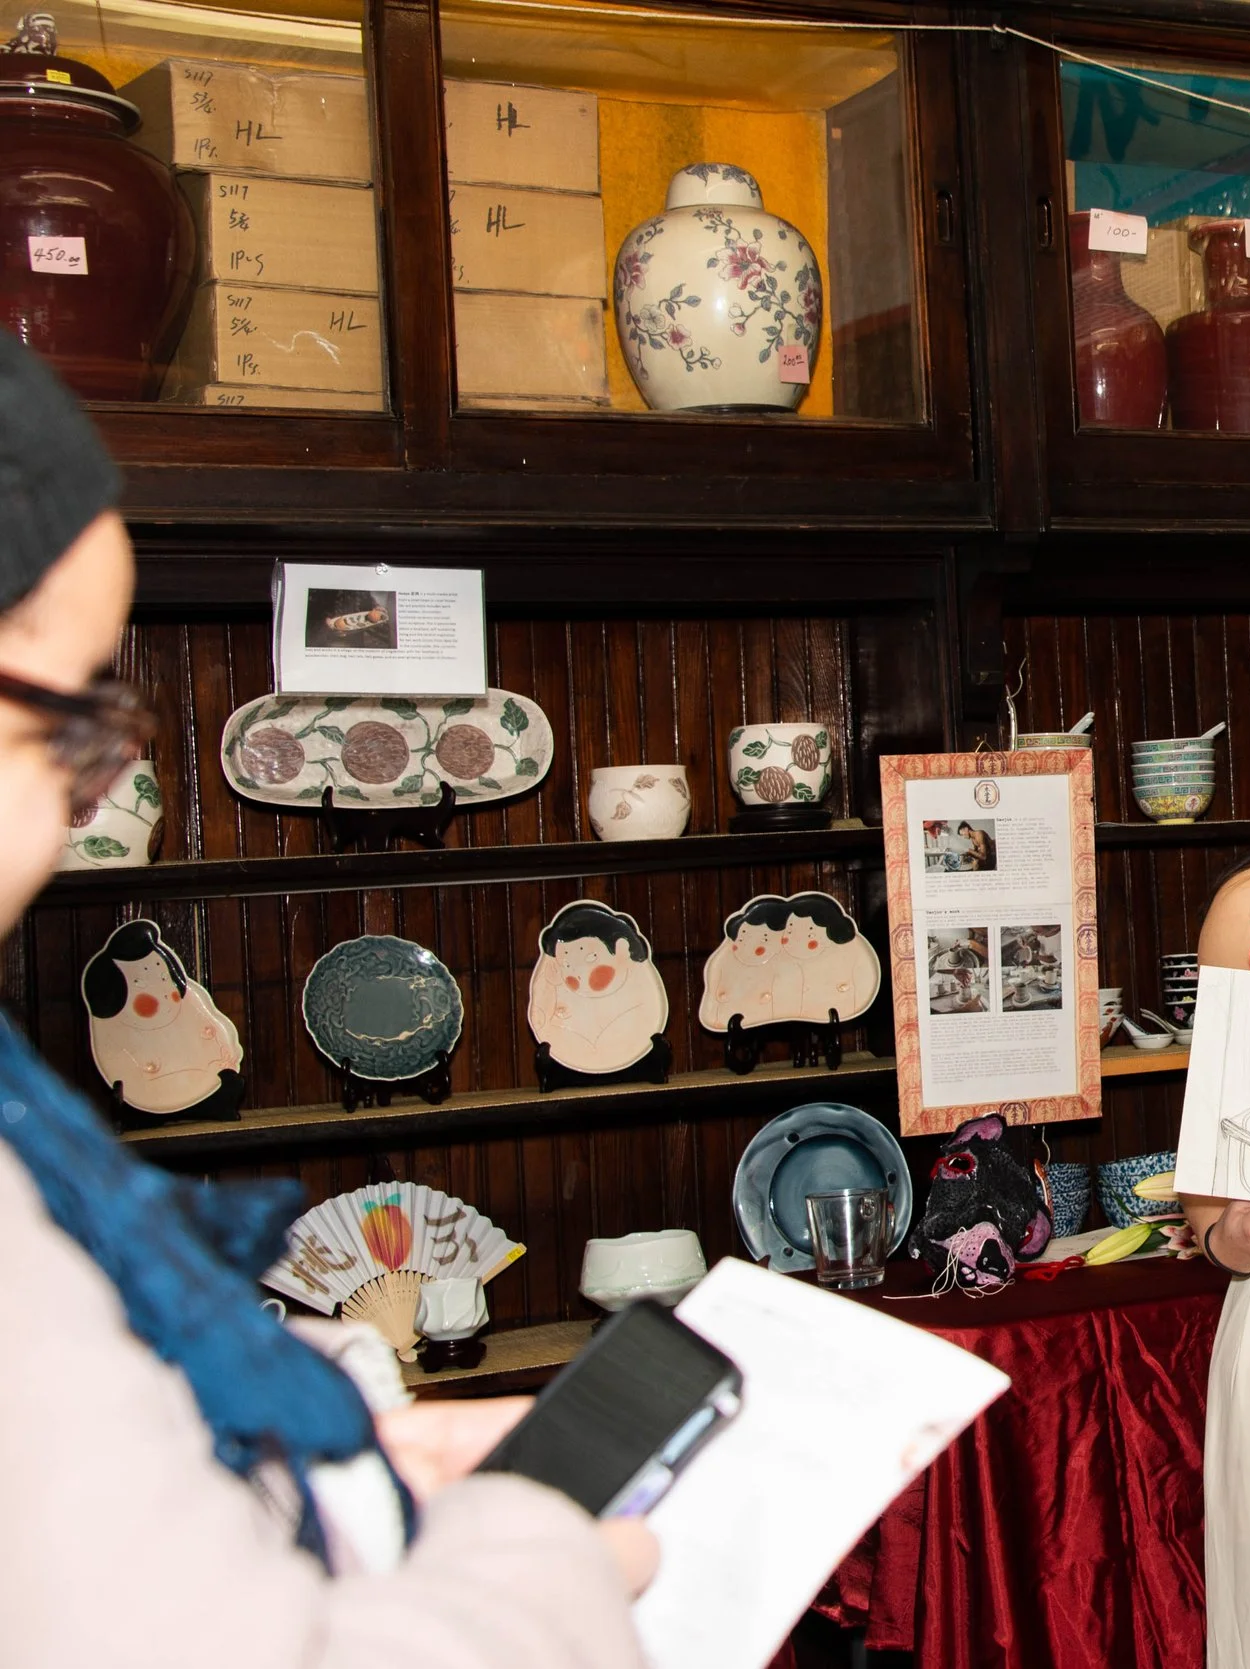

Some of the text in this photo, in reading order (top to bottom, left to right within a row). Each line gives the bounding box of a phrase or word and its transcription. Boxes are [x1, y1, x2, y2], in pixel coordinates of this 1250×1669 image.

[184, 69, 213, 87] S117
[235, 120, 283, 146] HL
[219, 185, 249, 200] S117
[487, 204, 526, 237] HL
[227, 294, 253, 310] S117
[329, 311, 367, 332] HL
[217, 394, 244, 405] S117
